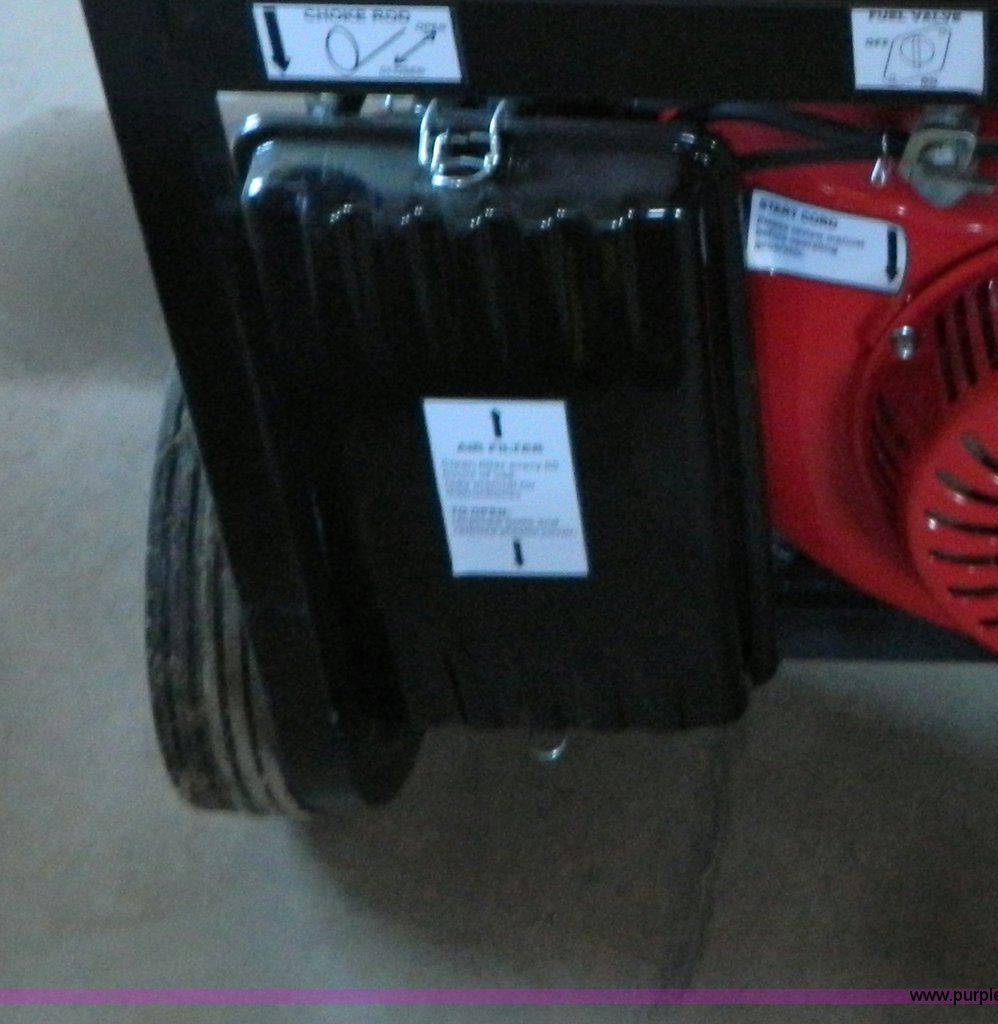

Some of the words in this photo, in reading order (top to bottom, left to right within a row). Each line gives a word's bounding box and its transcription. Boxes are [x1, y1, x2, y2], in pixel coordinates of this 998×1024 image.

[303, 7, 366, 21] CHOKE
[372, 8, 411, 22] ROD
[868, 9, 904, 21] FUEL
[911, 9, 962, 21] VALVE
[759, 197, 797, 219] START
[800, 208, 839, 228] CORD
[457, 441, 483, 452] AIR
[488, 441, 543, 453] FILTER
